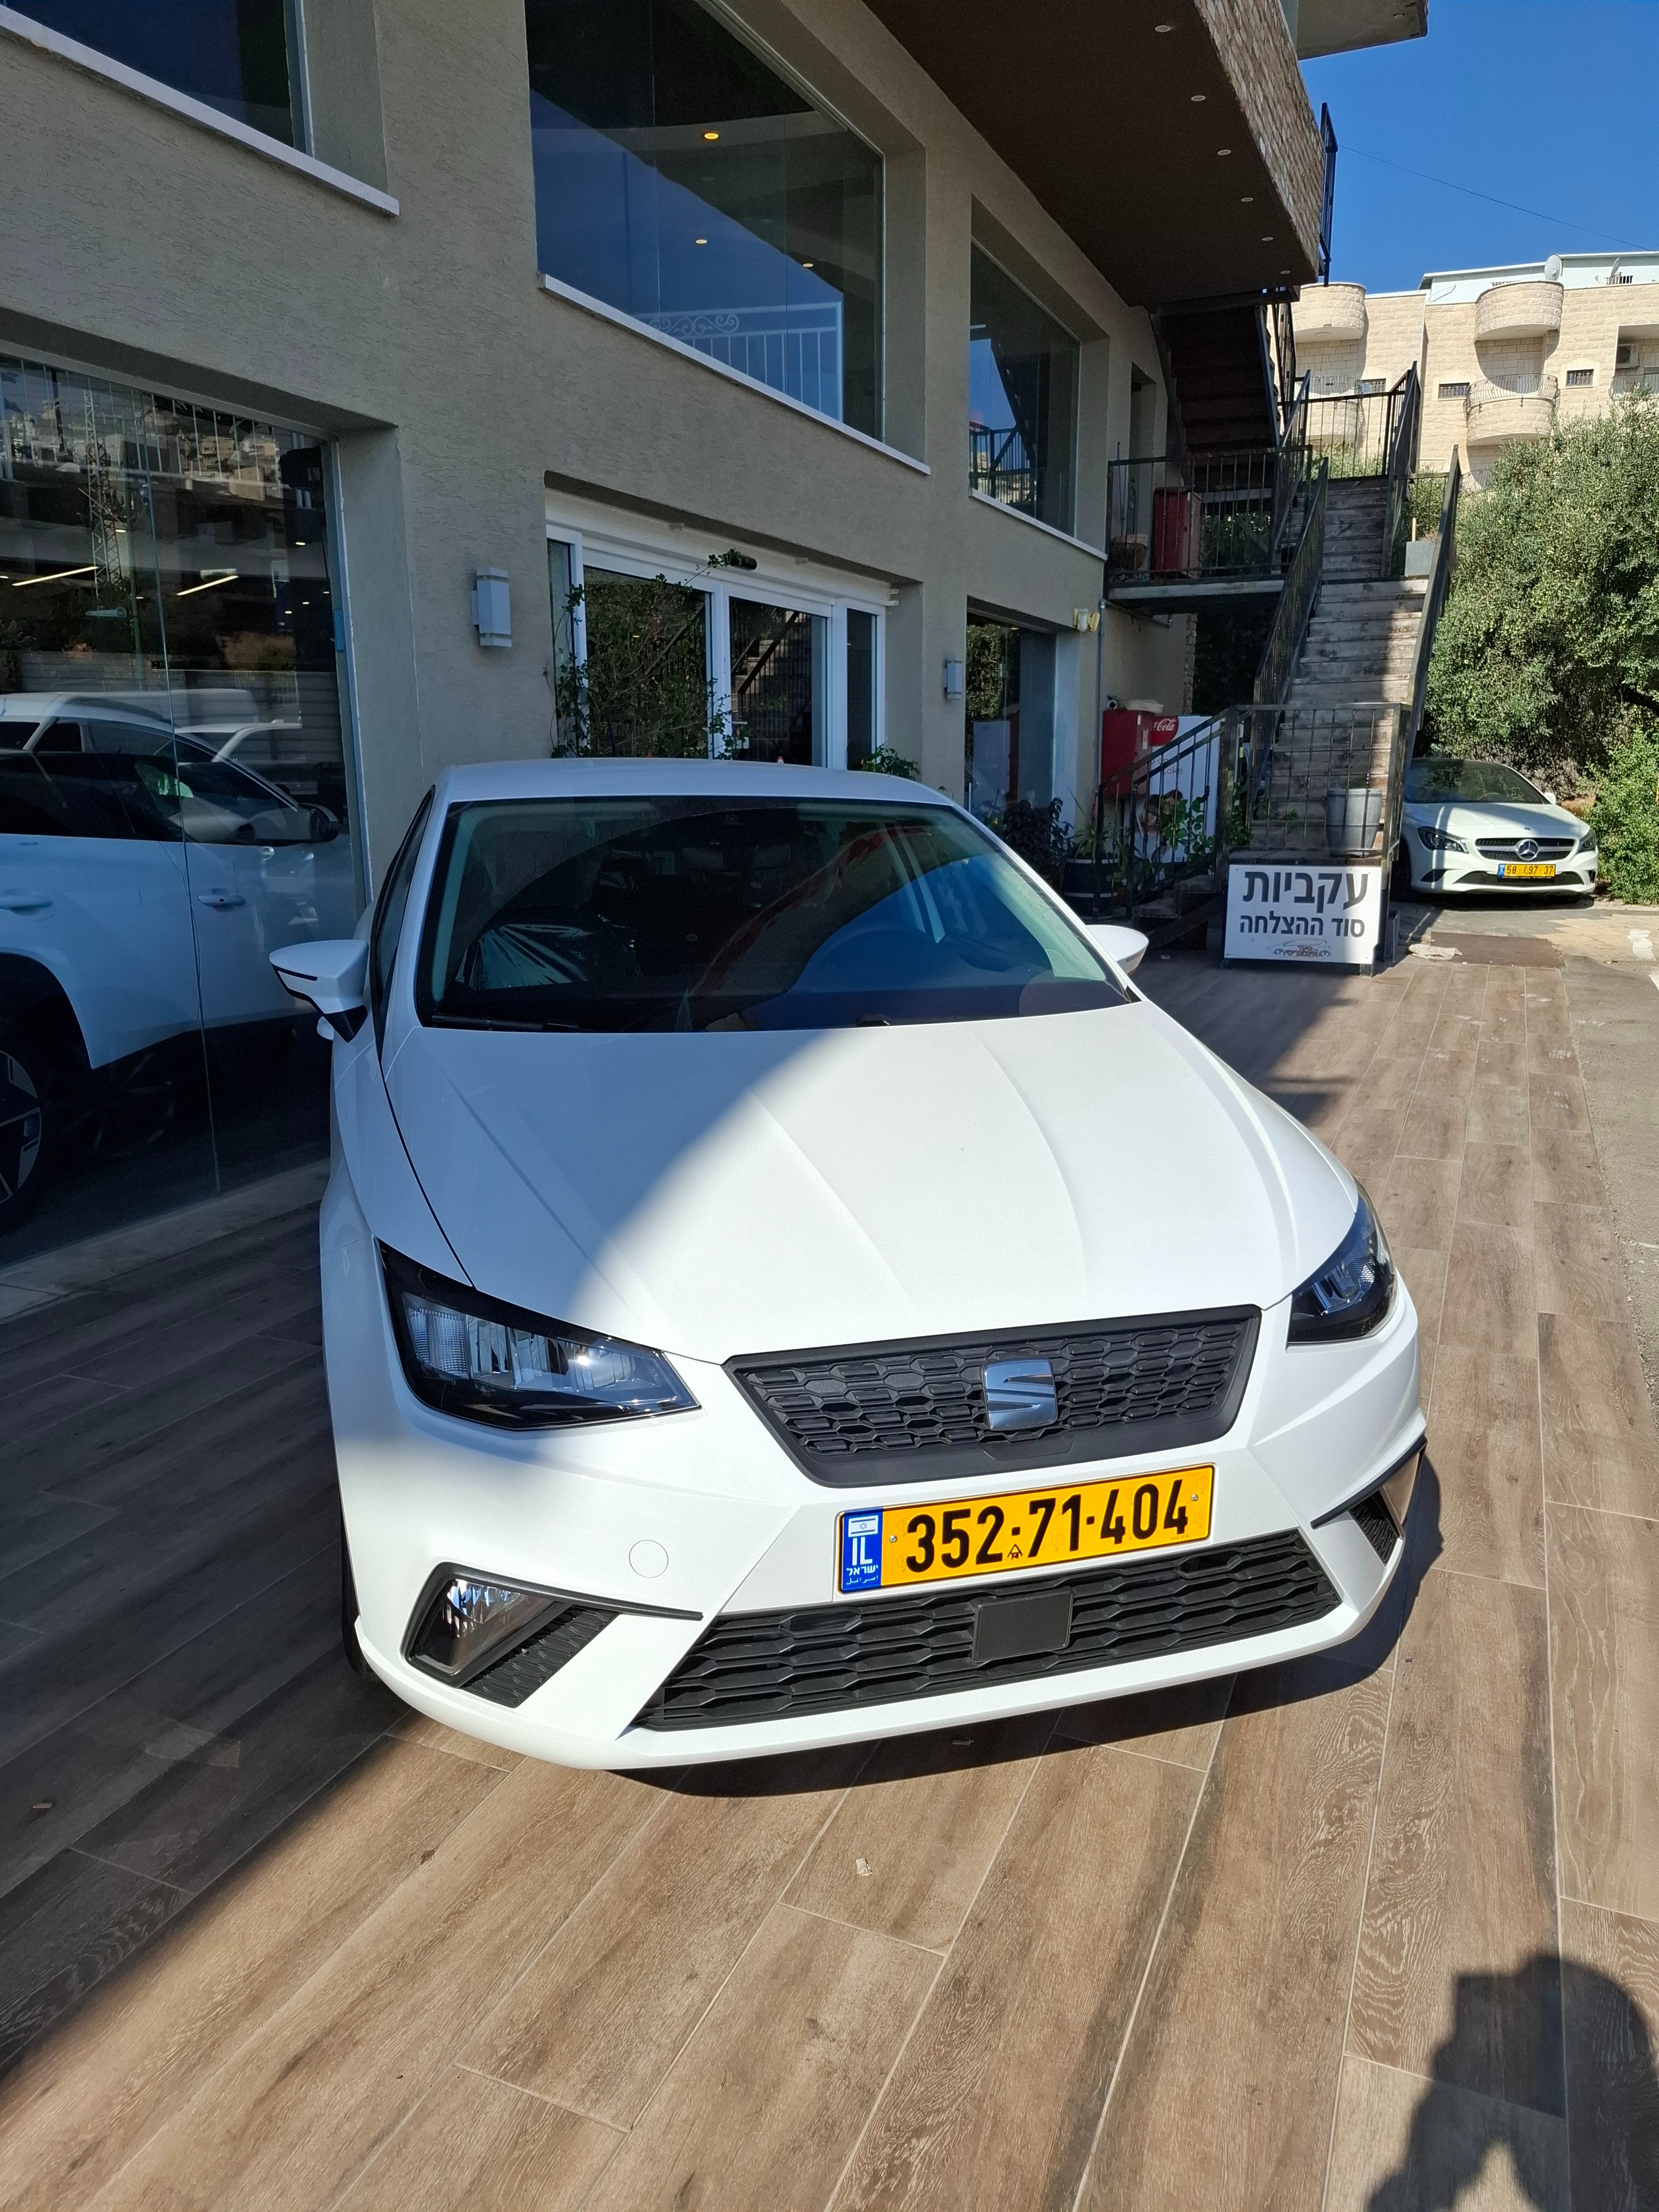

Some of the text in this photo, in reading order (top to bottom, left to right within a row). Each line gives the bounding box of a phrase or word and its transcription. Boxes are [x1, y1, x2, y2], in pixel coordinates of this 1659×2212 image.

[1242, 871, 1368, 914] עקביות
[1239, 911, 1365, 938] סוד ההצלחה
[852, 1536, 873, 1566] IL
[846, 1565, 878, 1576] ישראל
